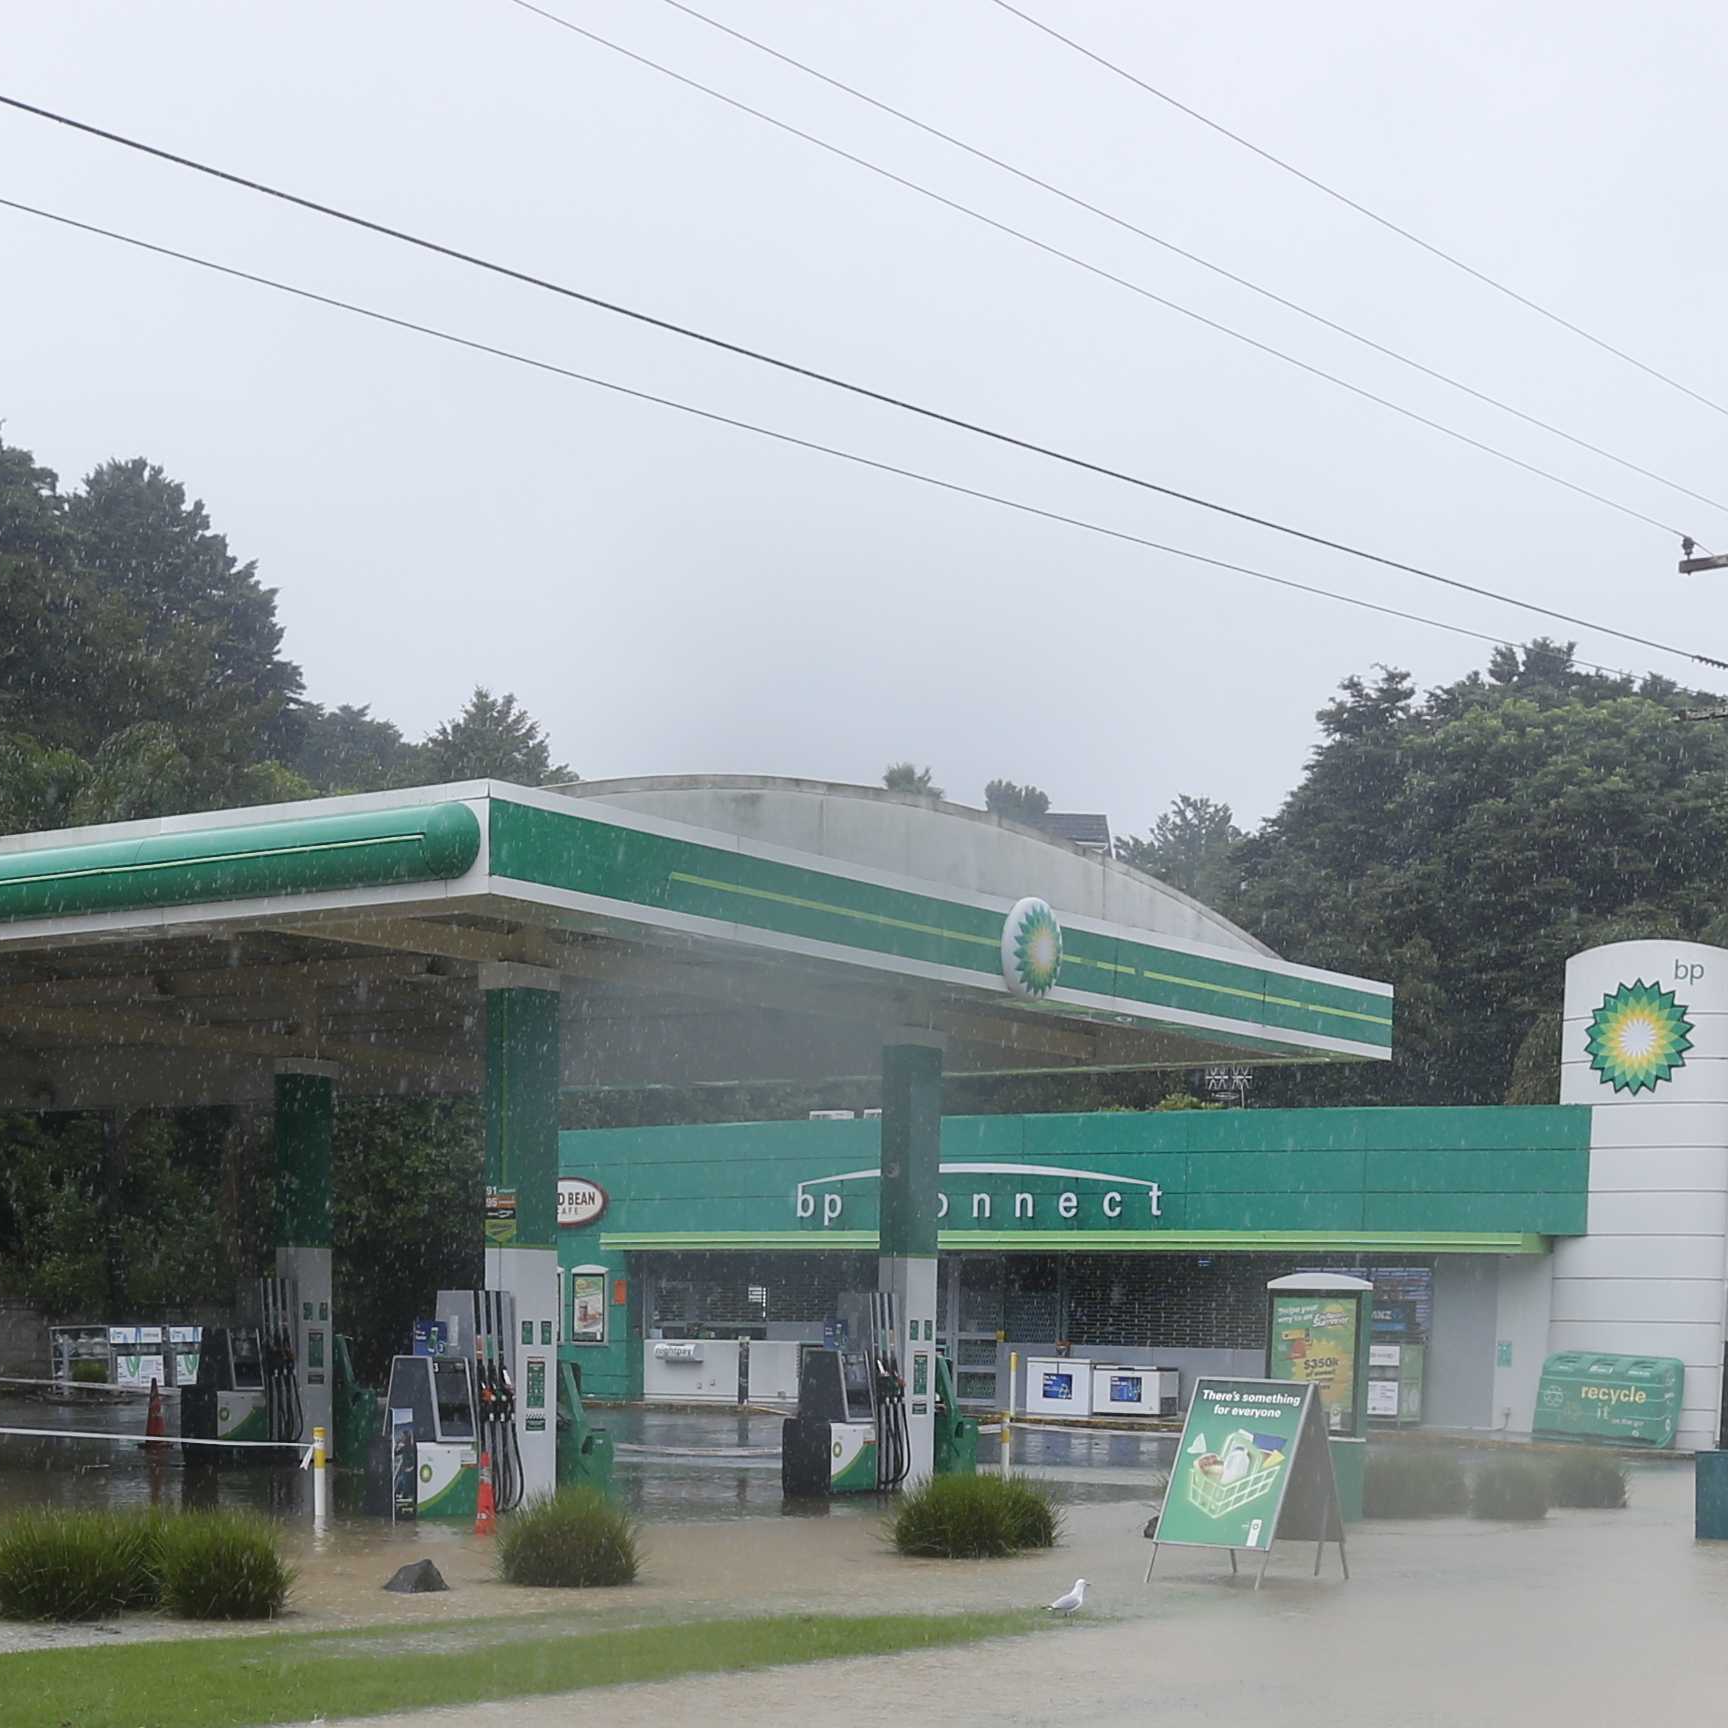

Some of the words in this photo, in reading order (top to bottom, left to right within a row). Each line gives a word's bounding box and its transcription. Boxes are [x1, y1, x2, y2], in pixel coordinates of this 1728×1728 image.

[1674, 958, 1704, 986] bp
[567, 1191, 596, 1206] BEAN
[797, 1183, 842, 1226] bp
[937, 1183, 1163, 1218] onnect
[1203, 1389, 1241, 1402] There's
[1242, 1392, 1301, 1407] something
[1581, 1386, 1647, 1405] recycle
[1214, 1404, 1229, 1415] for
[1232, 1405, 1281, 1418] everyone
[1597, 1402, 1609, 1420] it
